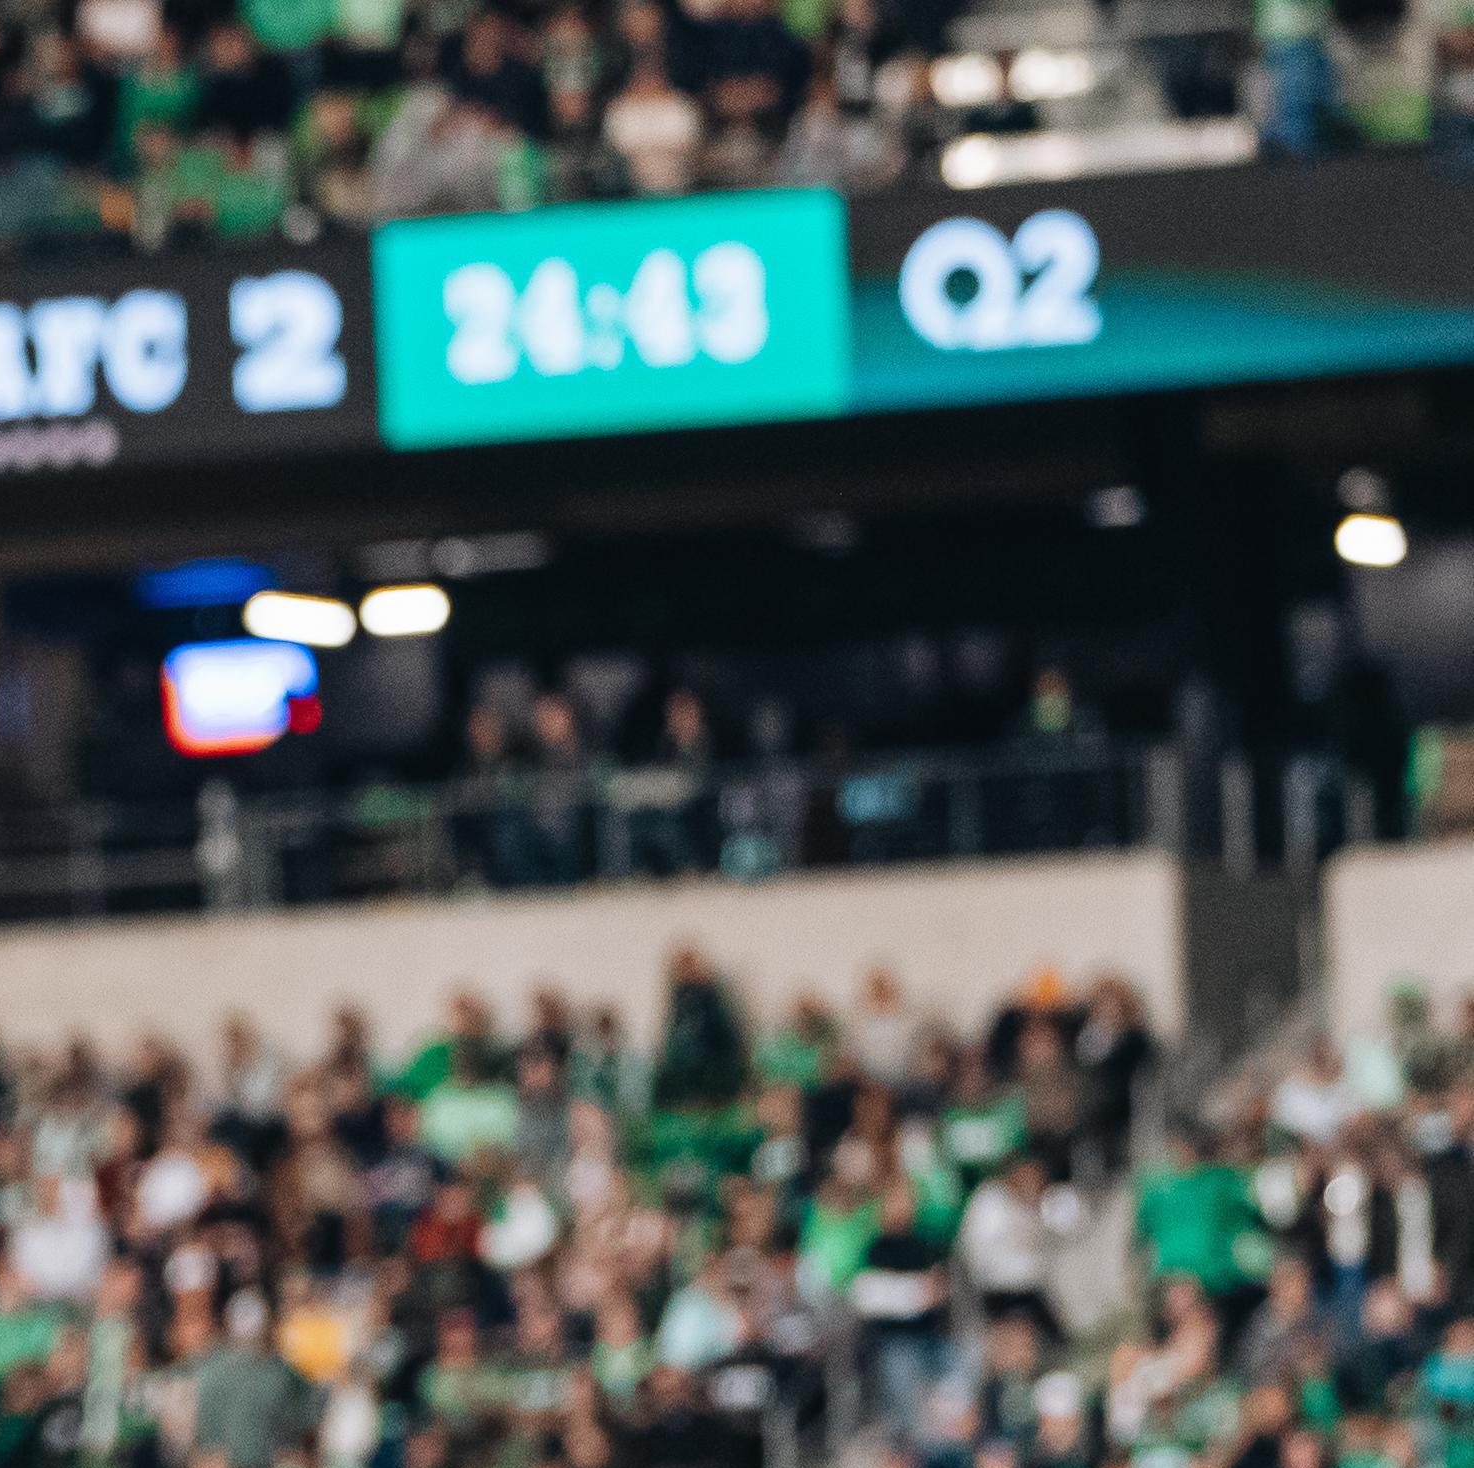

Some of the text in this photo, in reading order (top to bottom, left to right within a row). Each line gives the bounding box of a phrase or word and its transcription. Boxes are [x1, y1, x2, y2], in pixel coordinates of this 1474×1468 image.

[230, 272, 346, 412] 2
[444, 242, 769, 384] 24:43
[899, 210, 1102, 351] Q2
